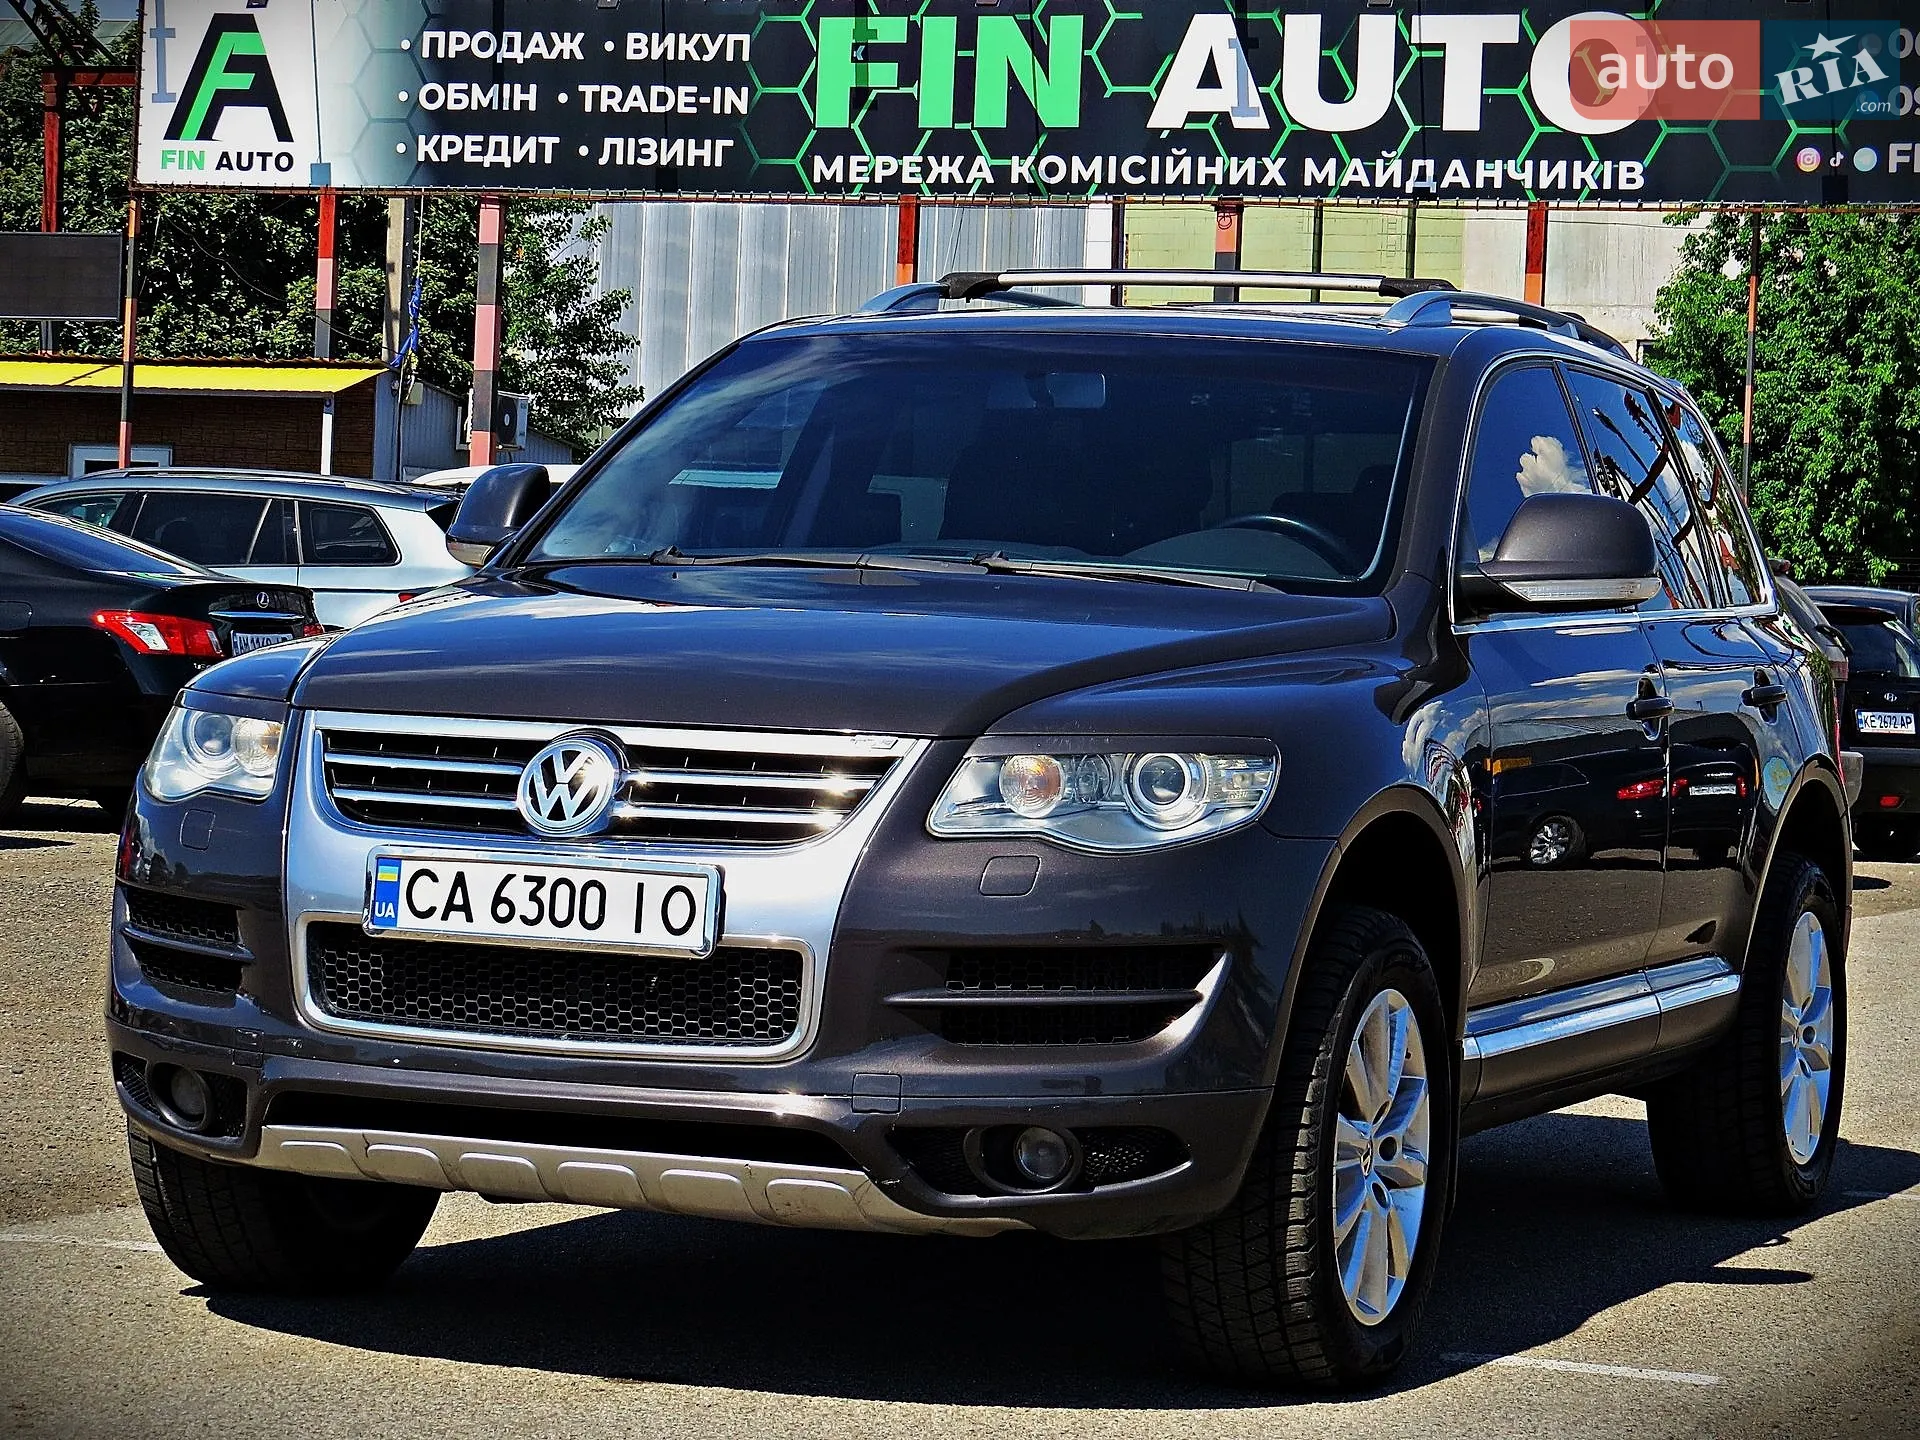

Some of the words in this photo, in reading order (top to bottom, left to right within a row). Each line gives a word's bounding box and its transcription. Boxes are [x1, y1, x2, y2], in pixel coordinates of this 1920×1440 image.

[421, 31, 585, 64] ПРОДАЖ
[626, 32, 751, 62] ВИКУП
[814, 15, 1084, 129] FIN
[1146, 12, 1657, 135] AUTO
[418, 83, 538, 111] ОБМІН
[577, 84, 749, 114] TRADE-IN
[160, 149, 206, 170] FIN
[215, 151, 294, 172] AUTO
[417, 134, 561, 168] КРЕДИТ
[598, 137, 734, 167] ЛІЗИНГ
[813, 155, 995, 185] МЕРЕЖА
[1010, 147, 1287, 187] КОМІСІЙНИХ
[1303, 150, 1646, 194] МАЙДАНЧИКІВ
[1901, 715, 1913, 729] AP
[374, 903, 396, 919] UA
[405, 868, 475, 924] CA
[490, 873, 608, 932] 6300
